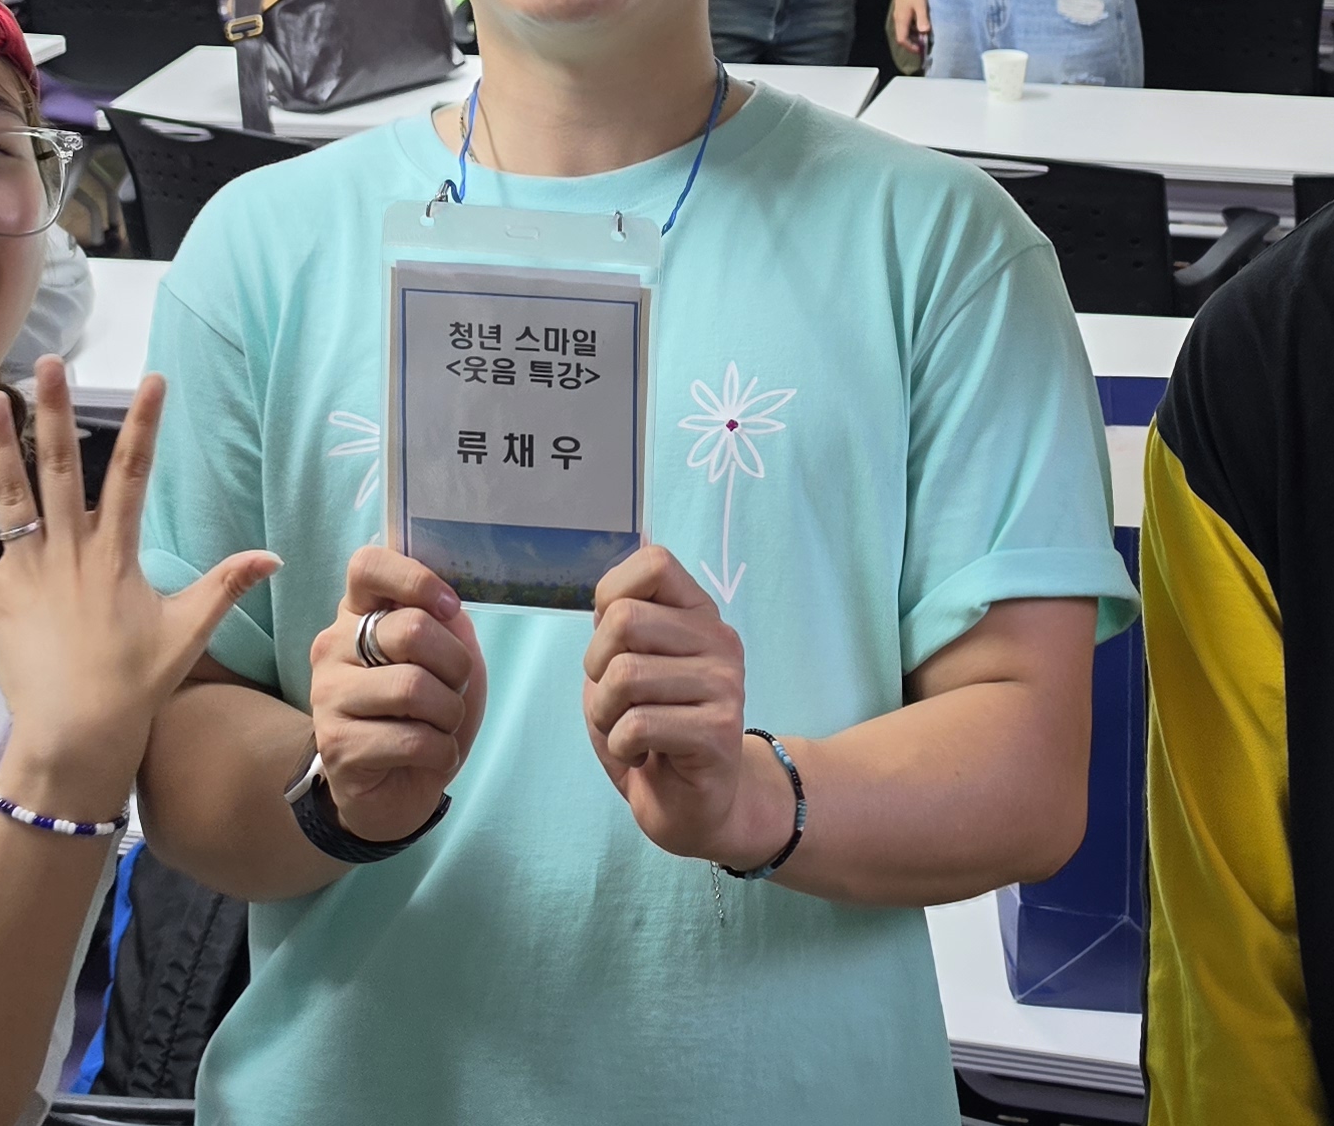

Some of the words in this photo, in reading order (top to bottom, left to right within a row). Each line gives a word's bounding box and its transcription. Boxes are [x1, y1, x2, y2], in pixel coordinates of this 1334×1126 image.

[449, 322, 502, 351] 청년
[515, 325, 597, 357] 스마일
[445, 356, 517, 386] <웃음
[529, 361, 601, 390] 특강>
